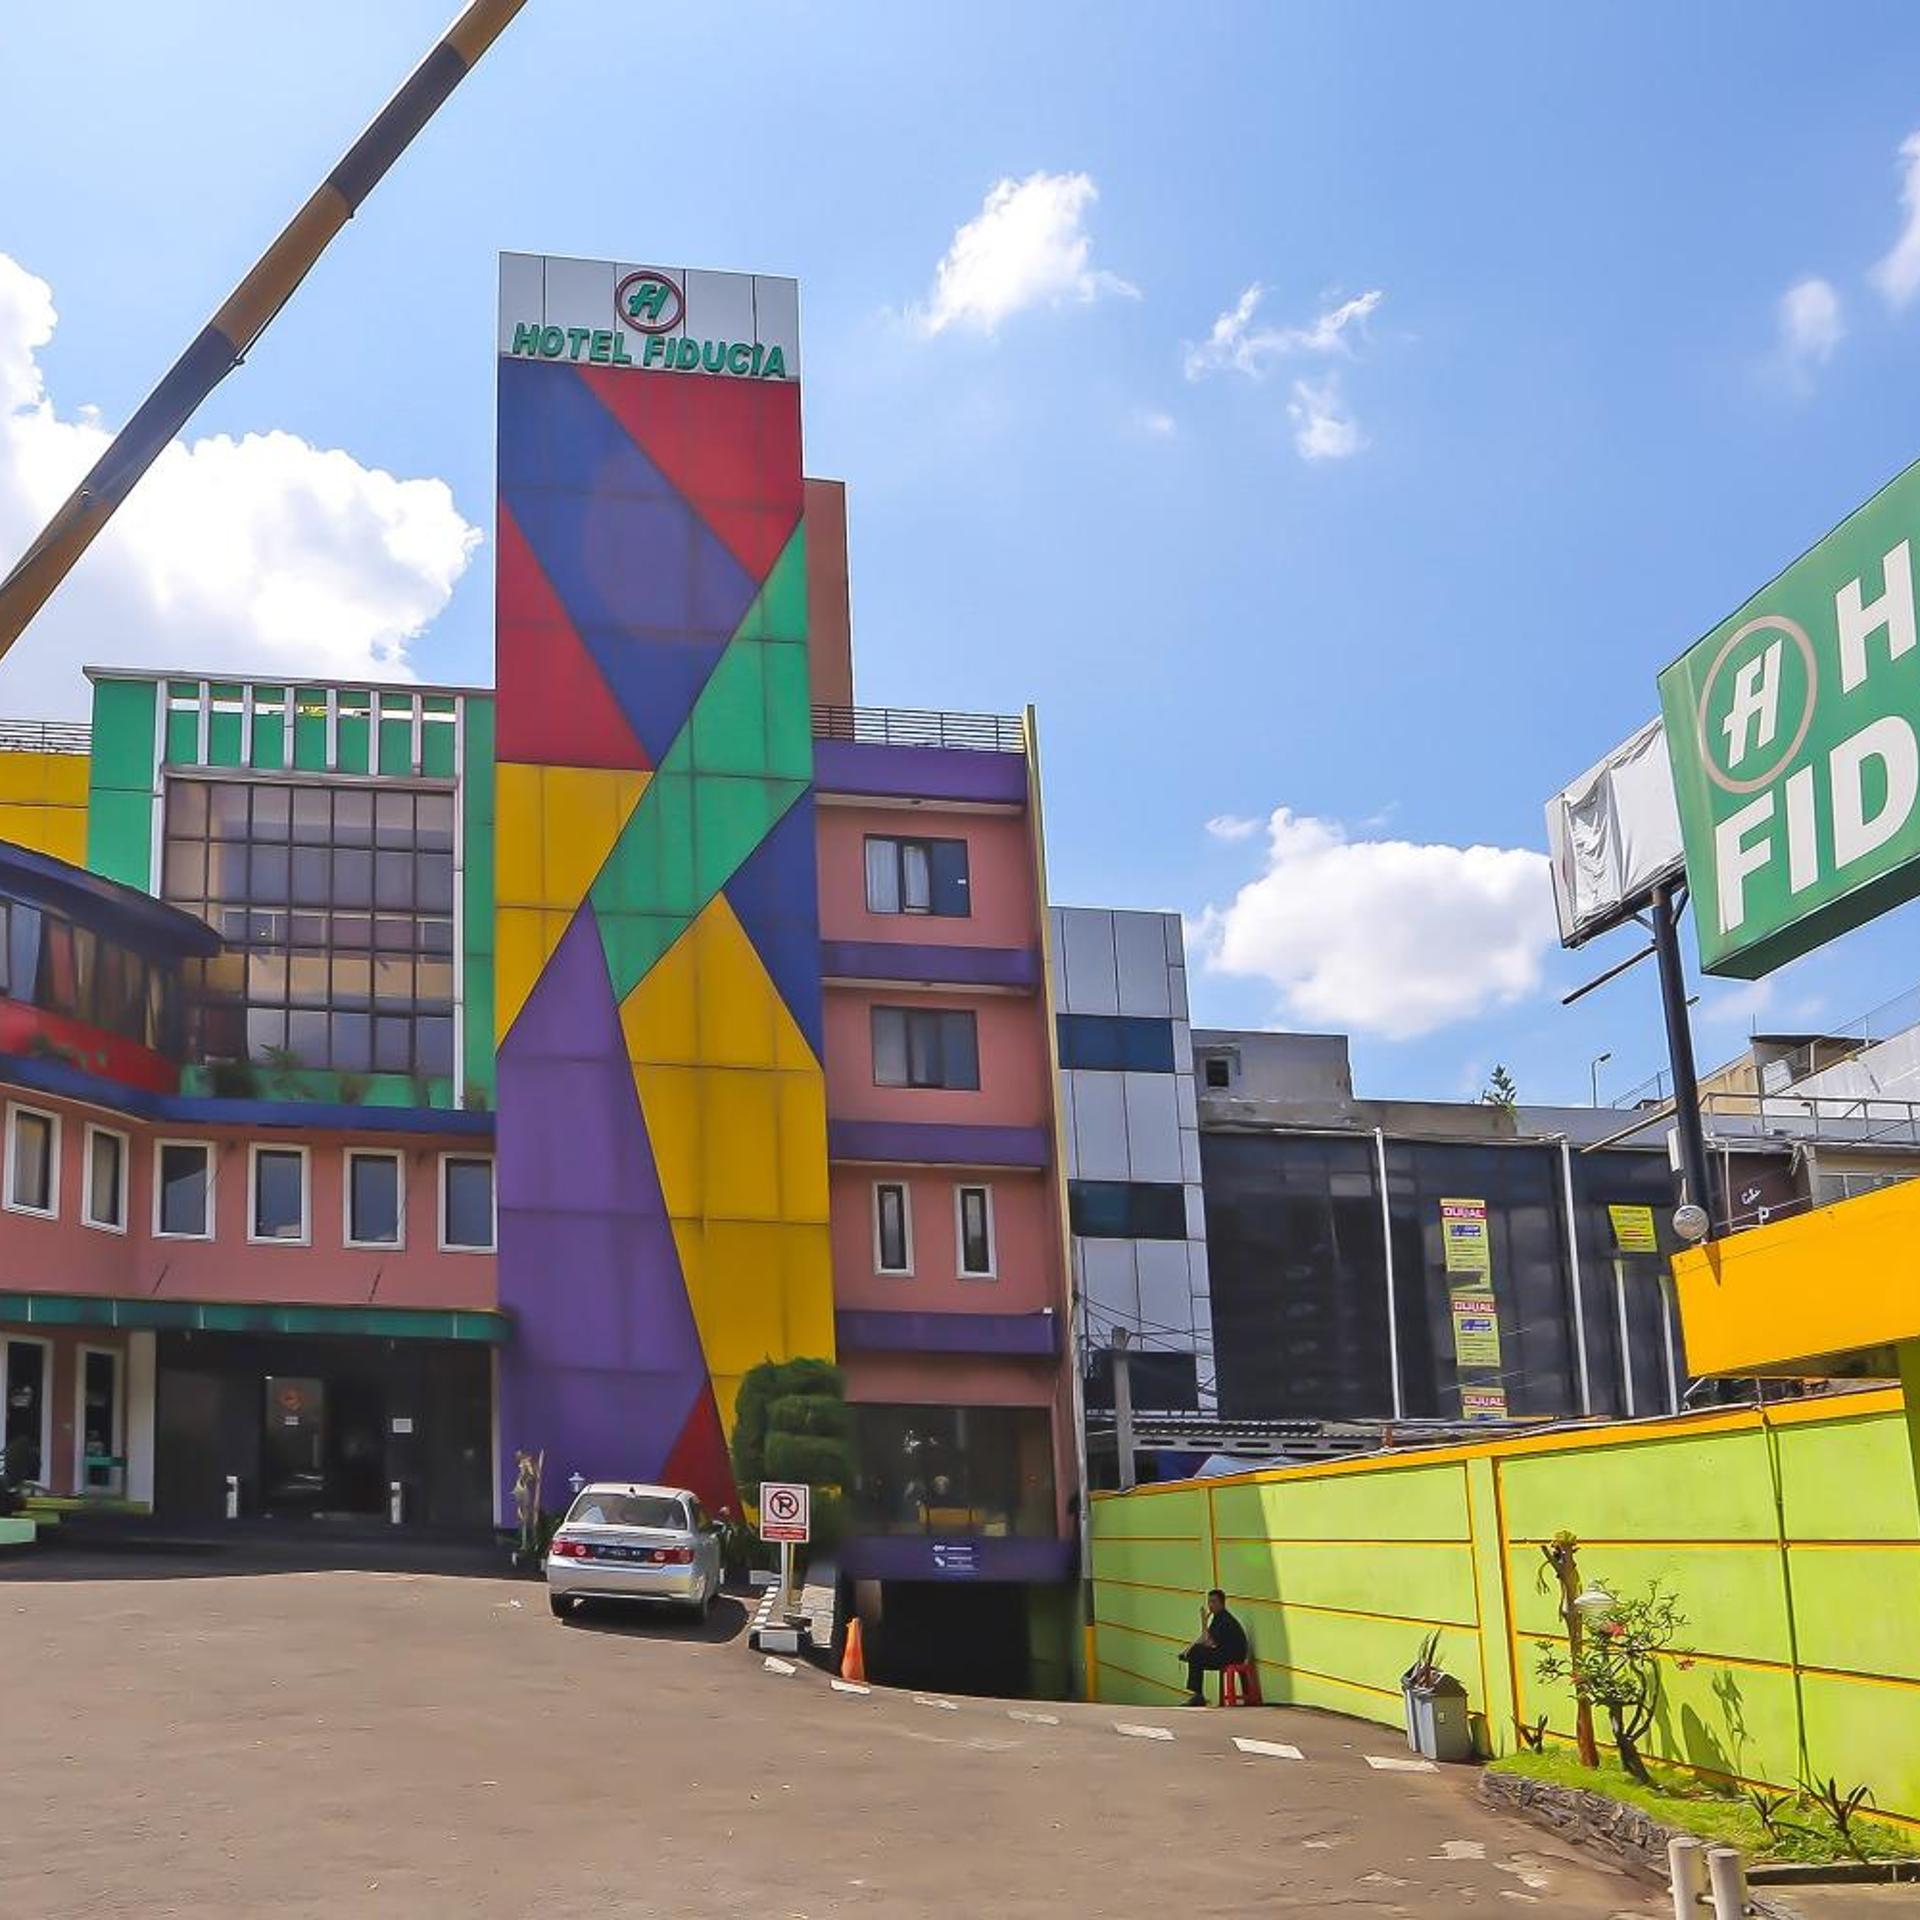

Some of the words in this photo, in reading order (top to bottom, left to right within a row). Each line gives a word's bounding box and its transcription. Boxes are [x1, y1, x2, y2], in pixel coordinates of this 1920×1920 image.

[512, 321, 632, 365] HOTEL
[642, 334, 787, 379] FIDUCIA
[1715, 714, 1920, 936] FID
